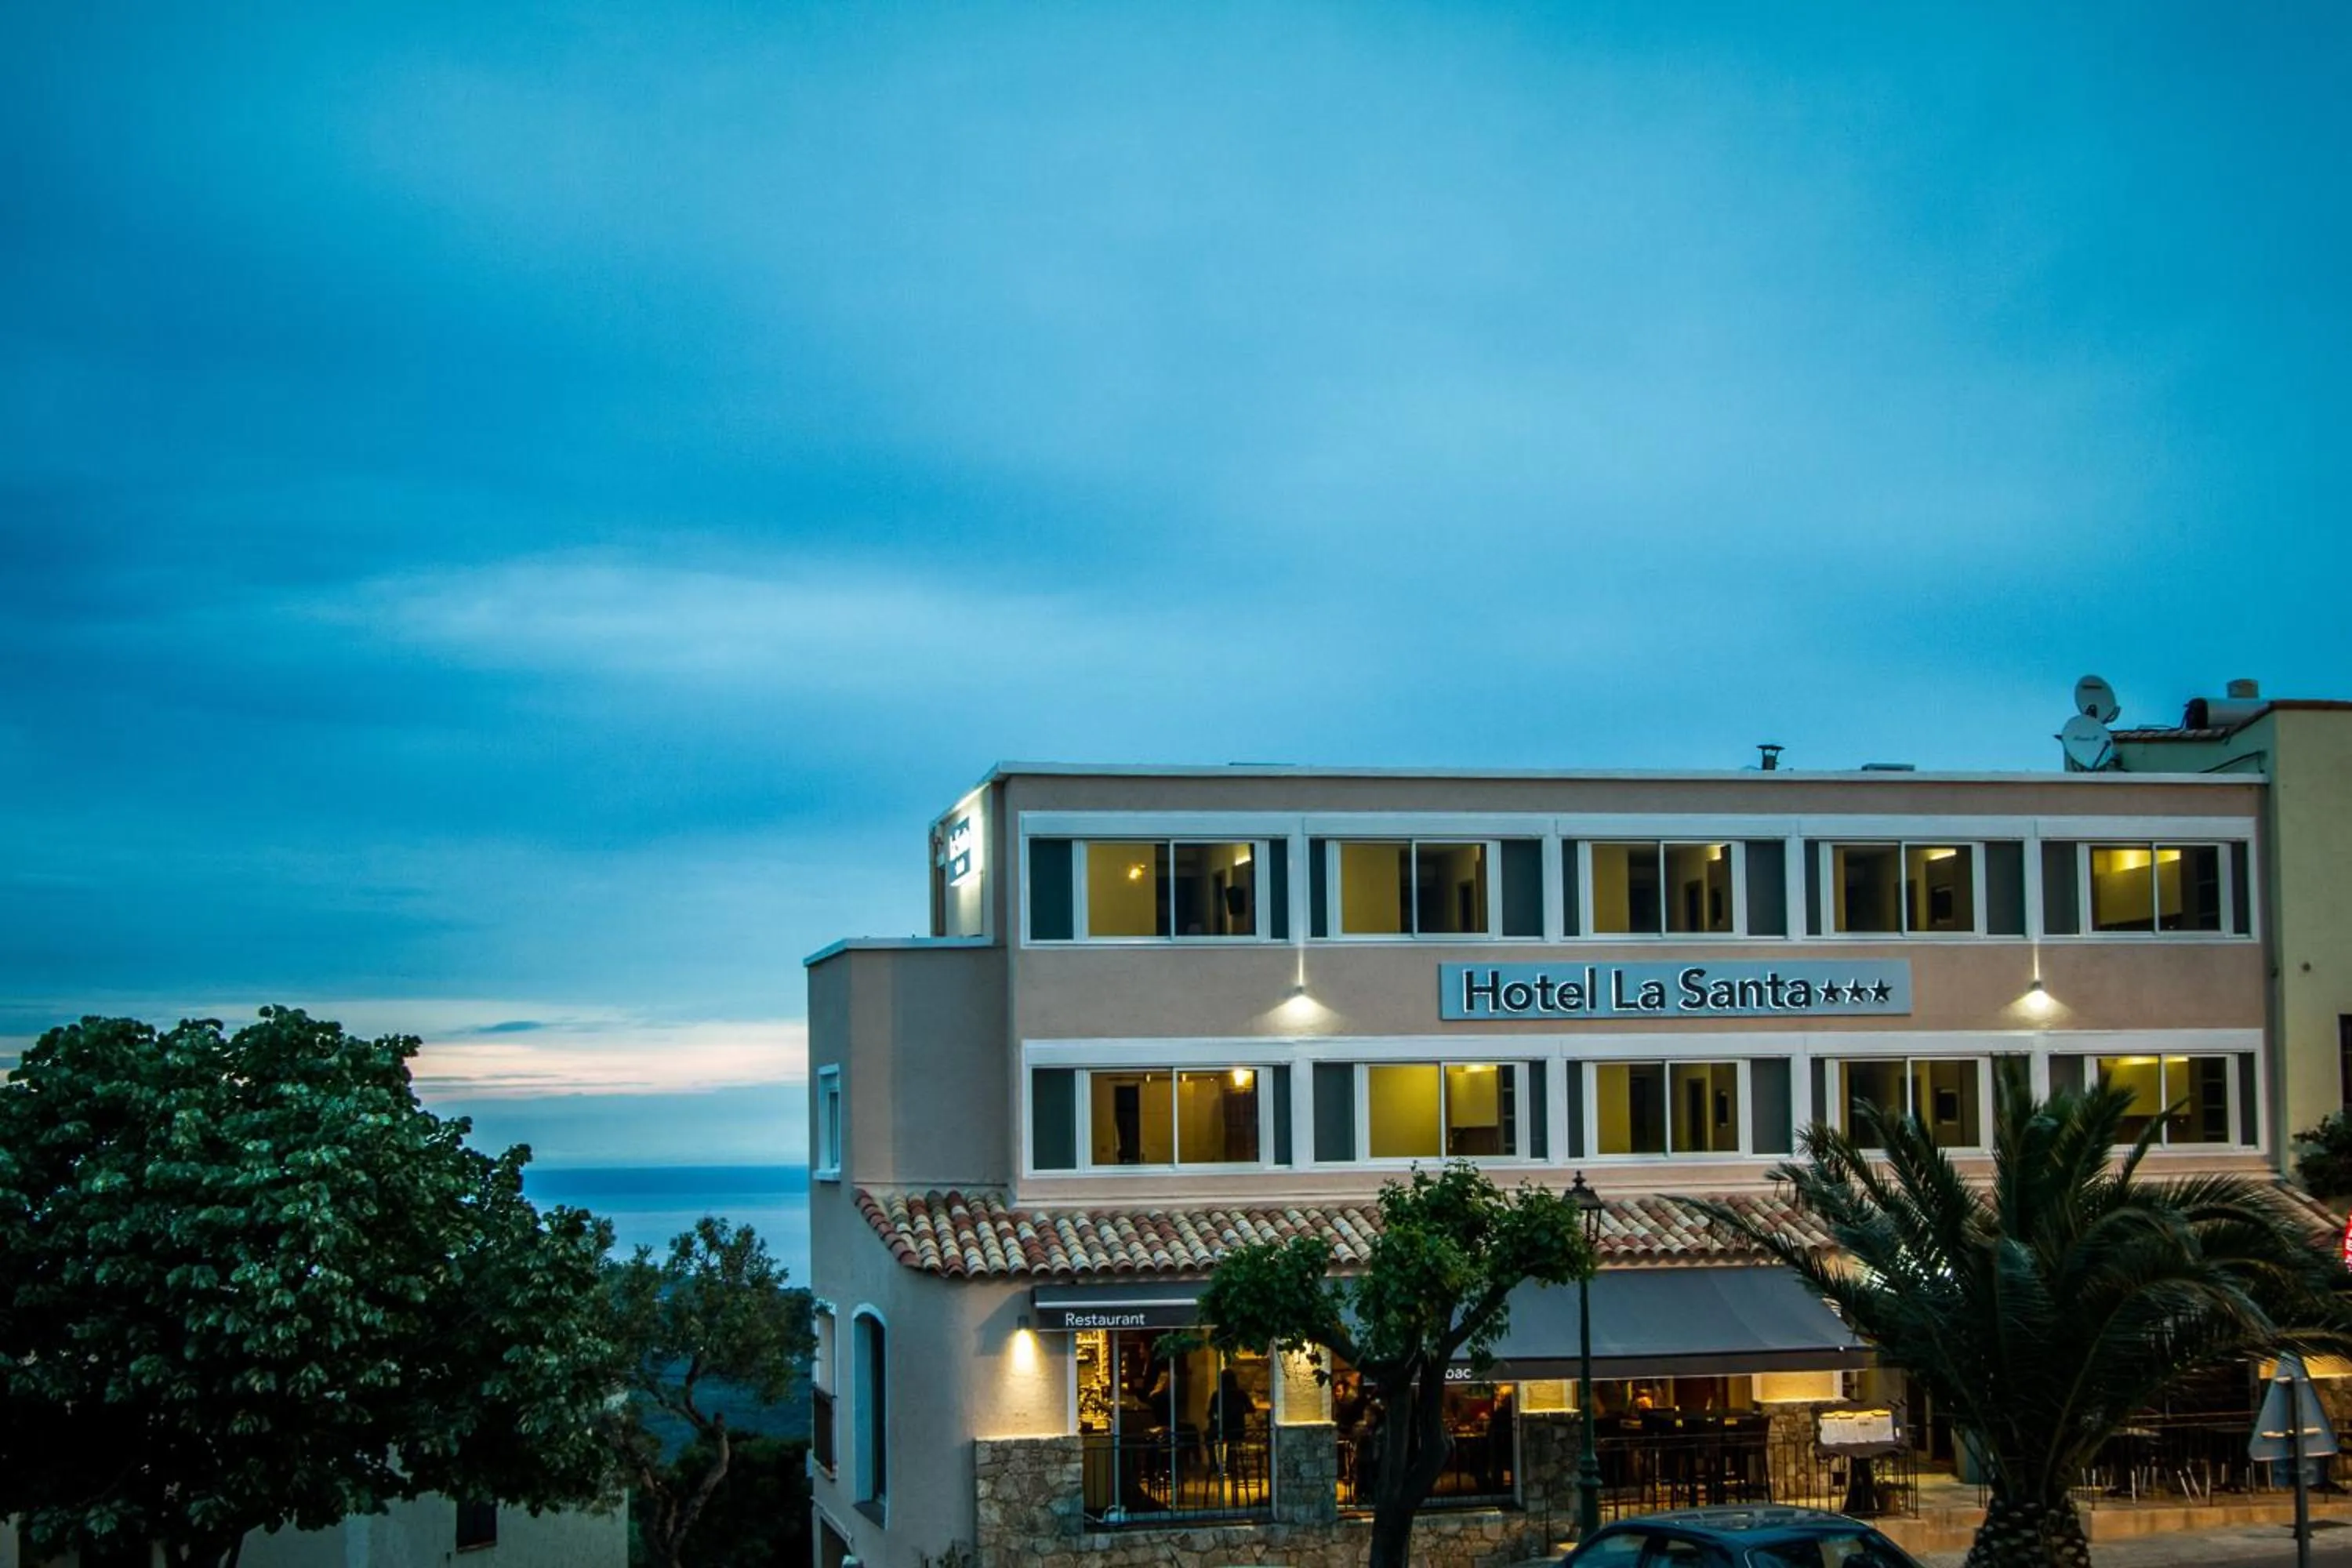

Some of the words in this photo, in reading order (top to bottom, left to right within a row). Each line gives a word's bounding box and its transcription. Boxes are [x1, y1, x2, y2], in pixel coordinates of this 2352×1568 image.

[1463, 966, 1595, 1012] Hotel
[1611, 969, 1665, 1012] La
[1678, 967, 1812, 1012] Santa
[1065, 1312, 1145, 1326] Restaurant
